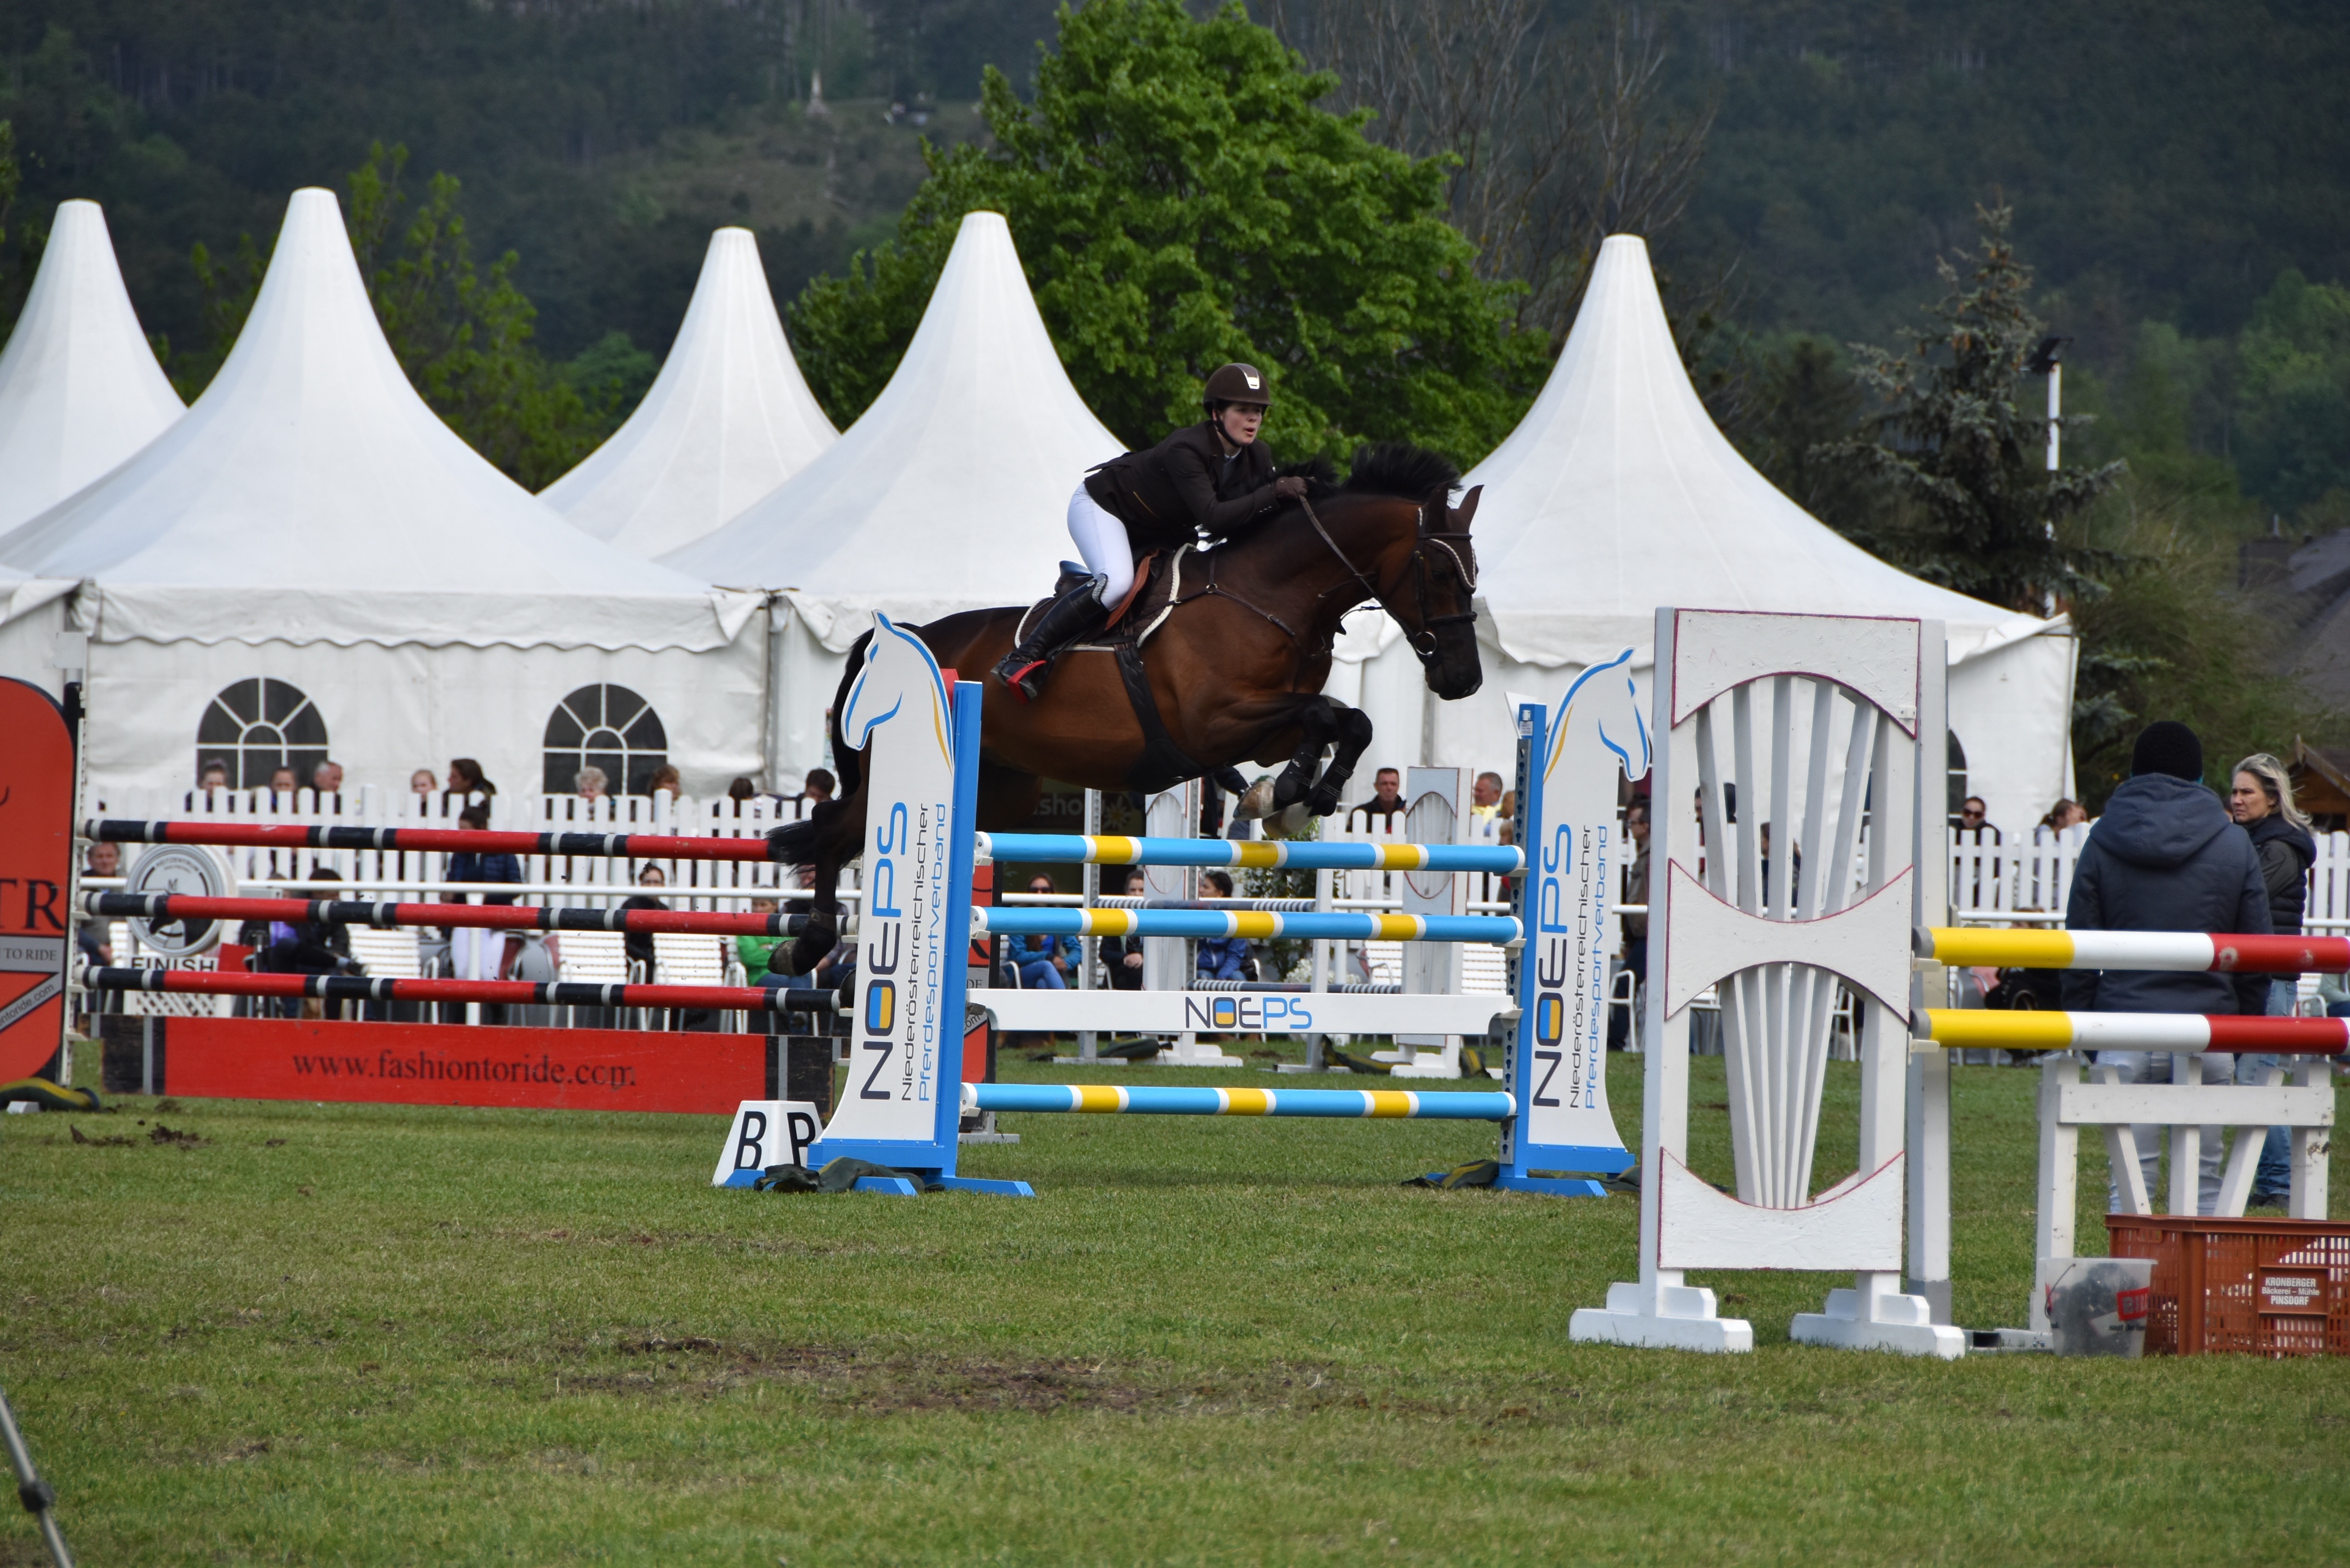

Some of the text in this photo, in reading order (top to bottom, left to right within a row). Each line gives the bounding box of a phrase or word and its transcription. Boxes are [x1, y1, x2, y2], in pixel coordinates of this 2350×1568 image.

[5, 948, 57, 961] TO RIDE
[132, 957, 214, 971] FINISH
[860, 802, 908, 1100] NOEPS
[901, 803, 929, 1101] Niederösterreichischer
[918, 803, 946, 1101] Pferdesportverband
[1533, 824, 1572, 1108] NOEPS
[1570, 825, 1591, 1108] Niederösterreichischer
[1585, 826, 1607, 1109] Pferdesportverband
[1185, 996, 1312, 1029] NOEPS
[293, 1050, 636, 1086] www.fashiontoride.com
[733, 1111, 767, 1170] B
[787, 1112, 815, 1166] P
[2265, 1277, 2316, 1287] KRONBERGER
[2271, 1296, 2309, 1305] PINSDORF
